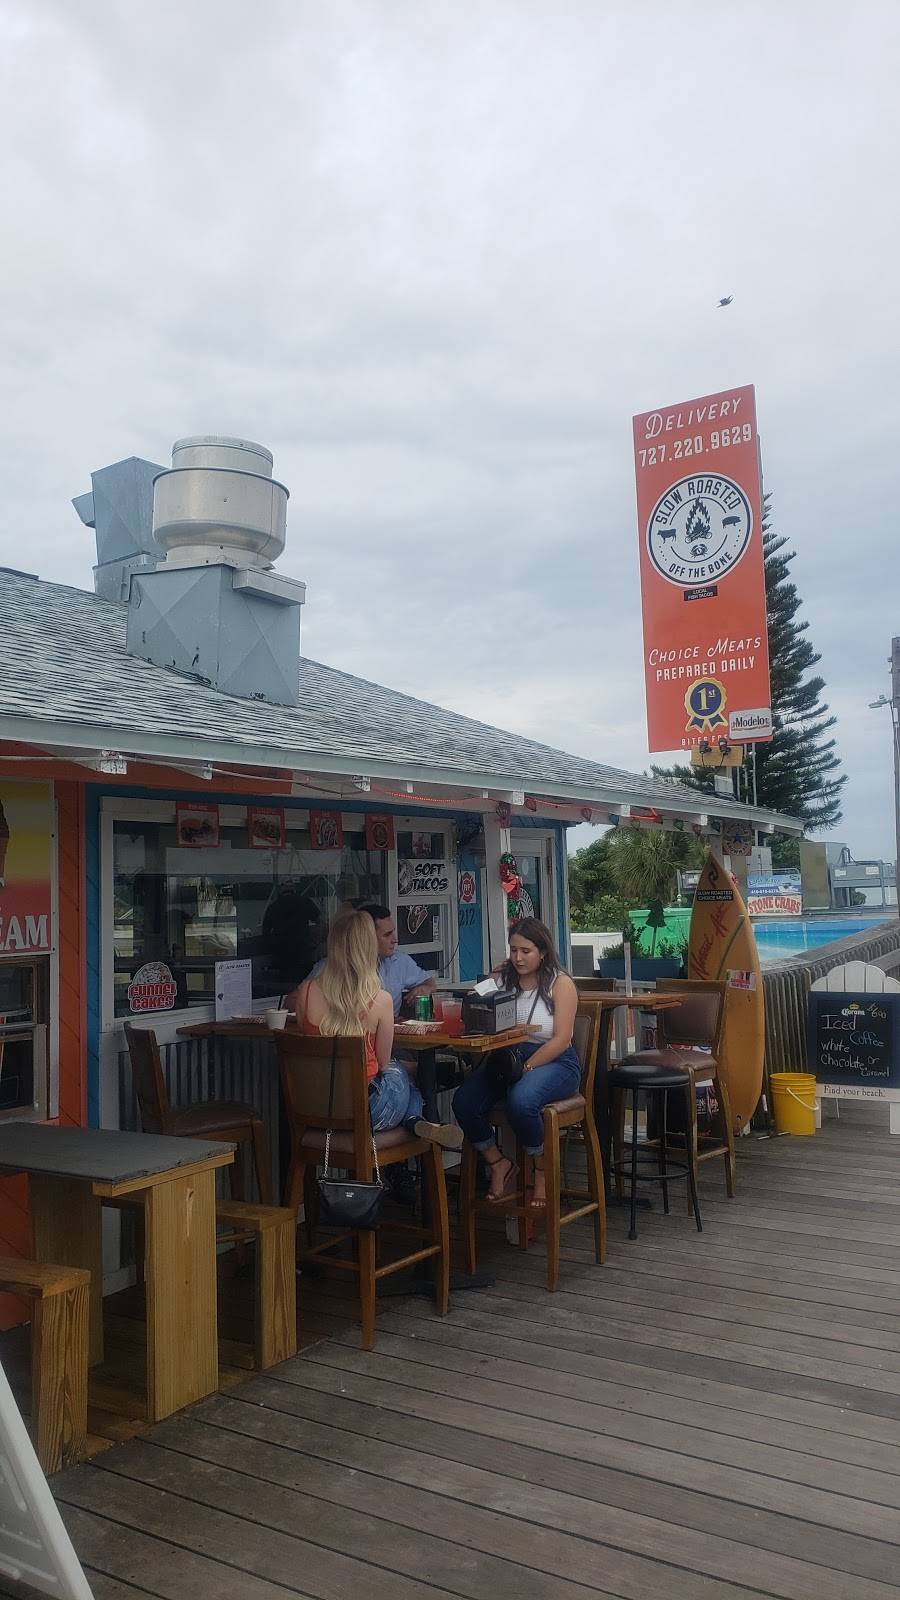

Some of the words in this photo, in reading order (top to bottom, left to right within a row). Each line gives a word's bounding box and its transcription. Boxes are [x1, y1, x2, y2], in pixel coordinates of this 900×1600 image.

[645, 398, 742, 439] DELIVERY
[639, 423, 752, 467] 727.220.9629
[656, 489, 683, 524] SLOW
[687, 479, 742, 510] ROASTED
[669, 562, 686, 578] OFF
[688, 566, 706, 578] THE
[708, 552, 733, 574] BONE
[649, 647, 700, 666] CHOICE
[707, 637, 762, 657] MEATS
[656, 664, 716, 682] PREPARED
[721, 656, 756, 673] DAILY
[414, 862, 446, 877] SOFT
[412, 877, 449, 892] TACOS
[748, 897, 774, 914] STONE
[775, 897, 801, 914] CRABS
[820, 1014, 857, 1031] Iced
[841, 1008, 866, 1016] Corona
[823, 1085, 840, 1095] Find
[842, 1088, 860, 1099] your
